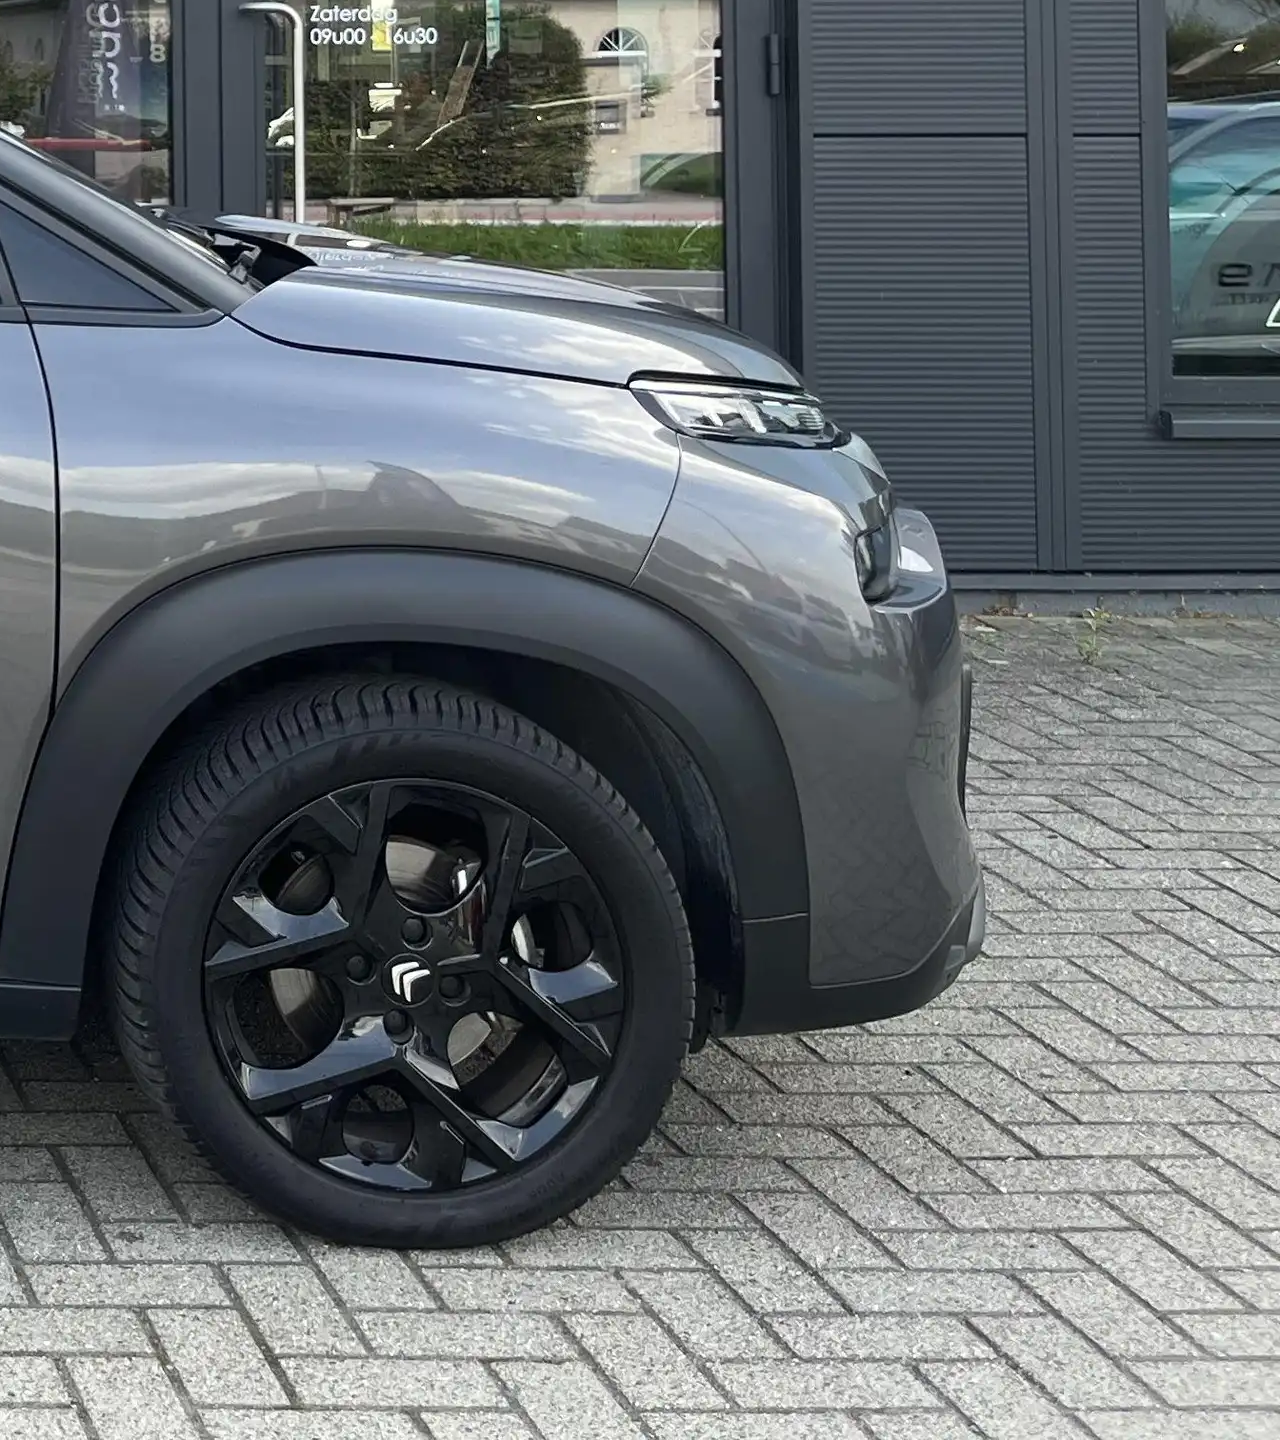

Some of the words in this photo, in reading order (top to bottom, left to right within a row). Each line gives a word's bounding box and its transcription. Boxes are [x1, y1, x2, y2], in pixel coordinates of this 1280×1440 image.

[309, 5, 398, 24] Zaterdag
[309, 28, 366, 45] 09u00
[387, 27, 438, 45] 6u30
